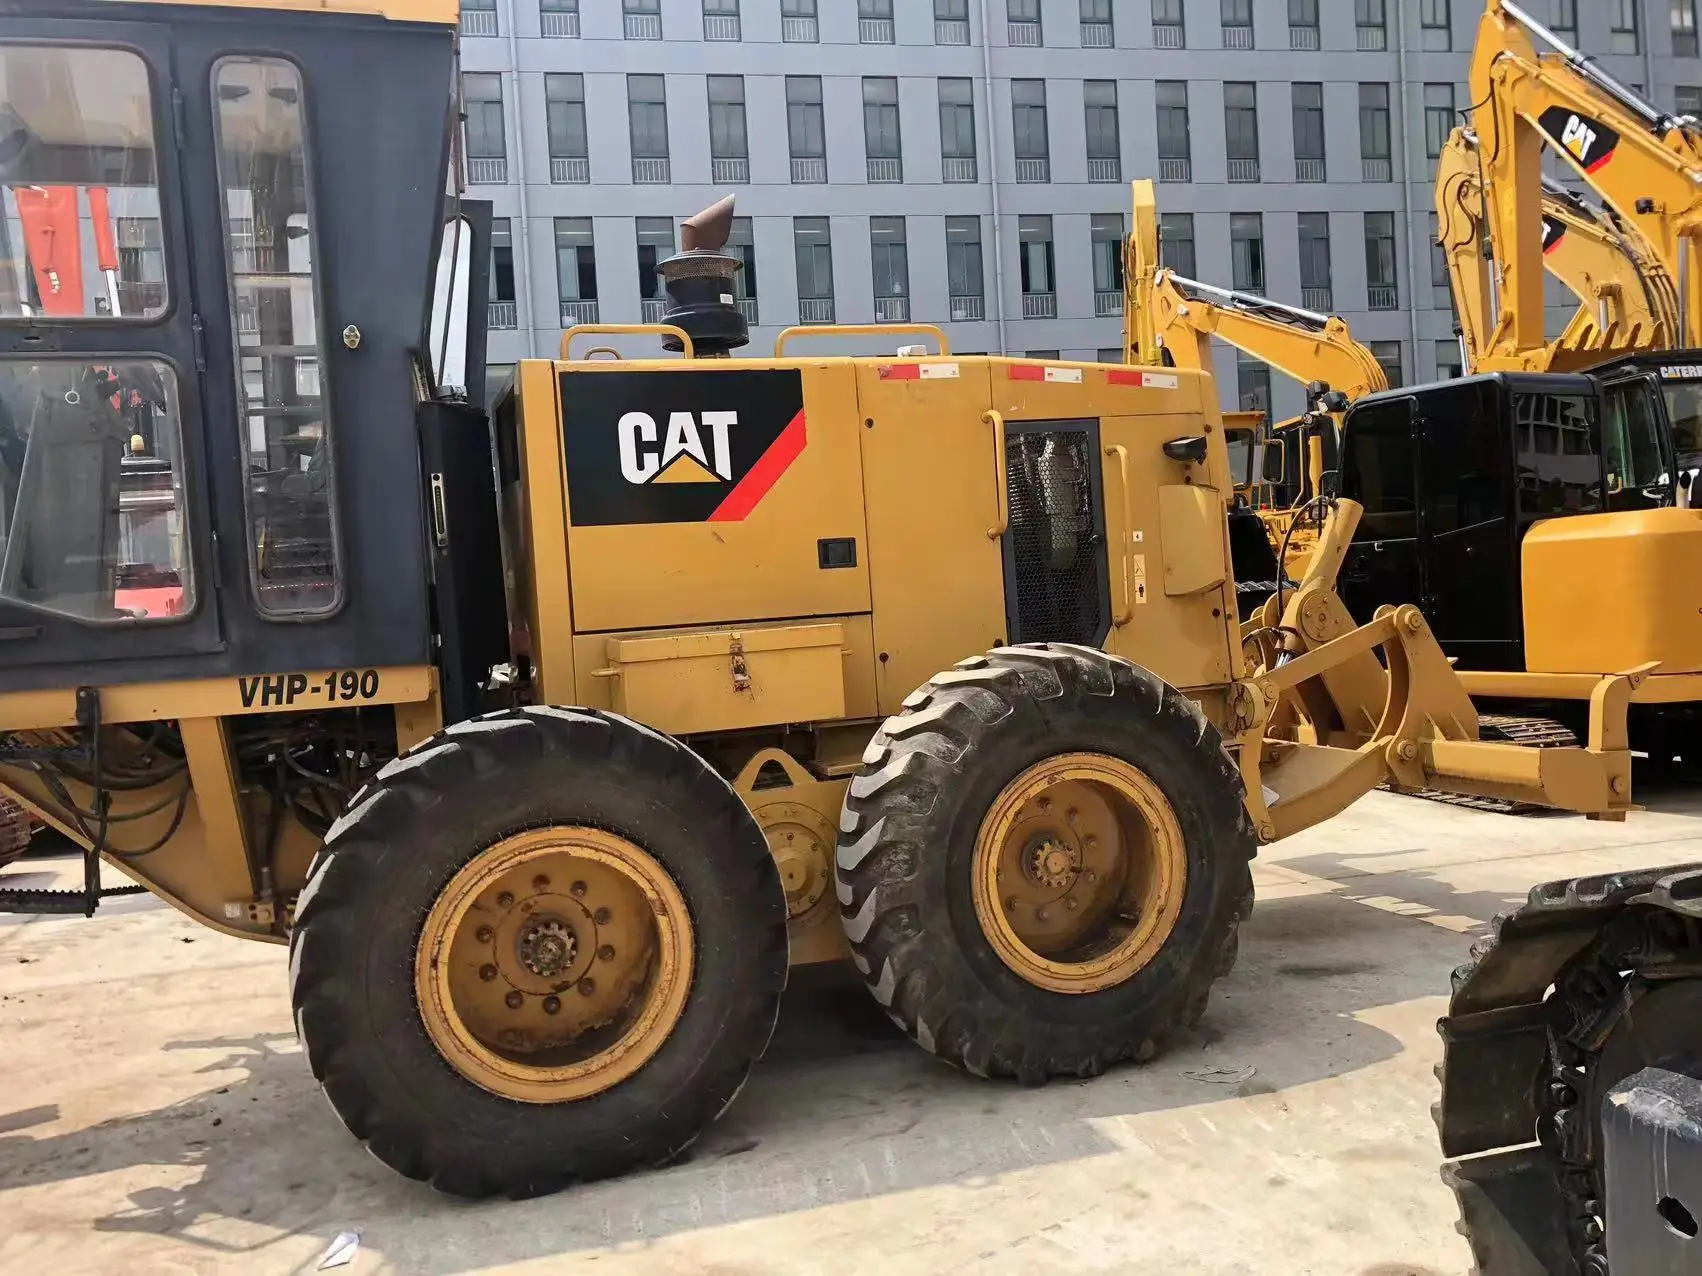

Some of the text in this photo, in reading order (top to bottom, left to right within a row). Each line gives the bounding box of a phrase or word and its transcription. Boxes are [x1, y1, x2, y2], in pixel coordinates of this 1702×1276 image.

[1561, 114, 1597, 162] CAT
[618, 410, 738, 485] CAT
[238, 669, 379, 708] VHP-190
